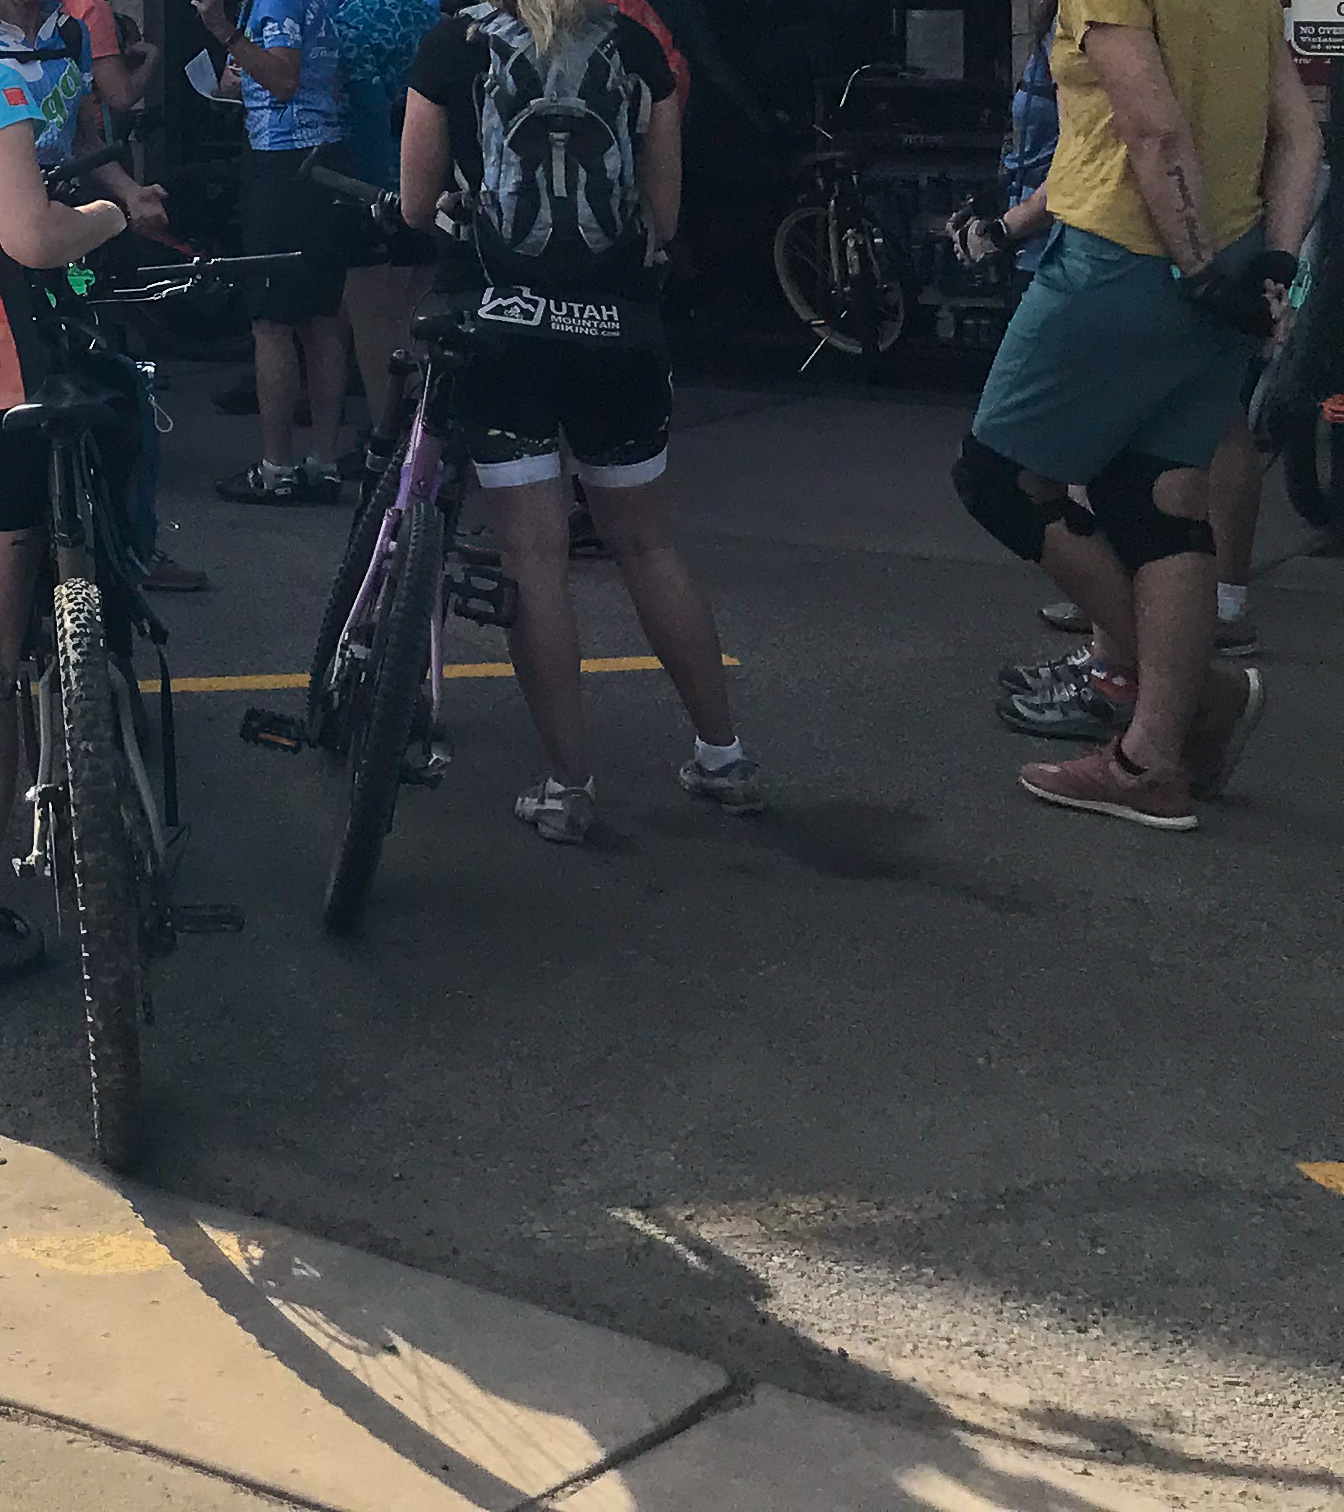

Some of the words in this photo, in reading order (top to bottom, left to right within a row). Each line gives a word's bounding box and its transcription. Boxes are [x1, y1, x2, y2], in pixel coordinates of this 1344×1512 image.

[549, 299, 619, 321] UTAH
[550, 314, 620, 329] MOUNTAIN
[550, 322, 599, 336] BIKING
